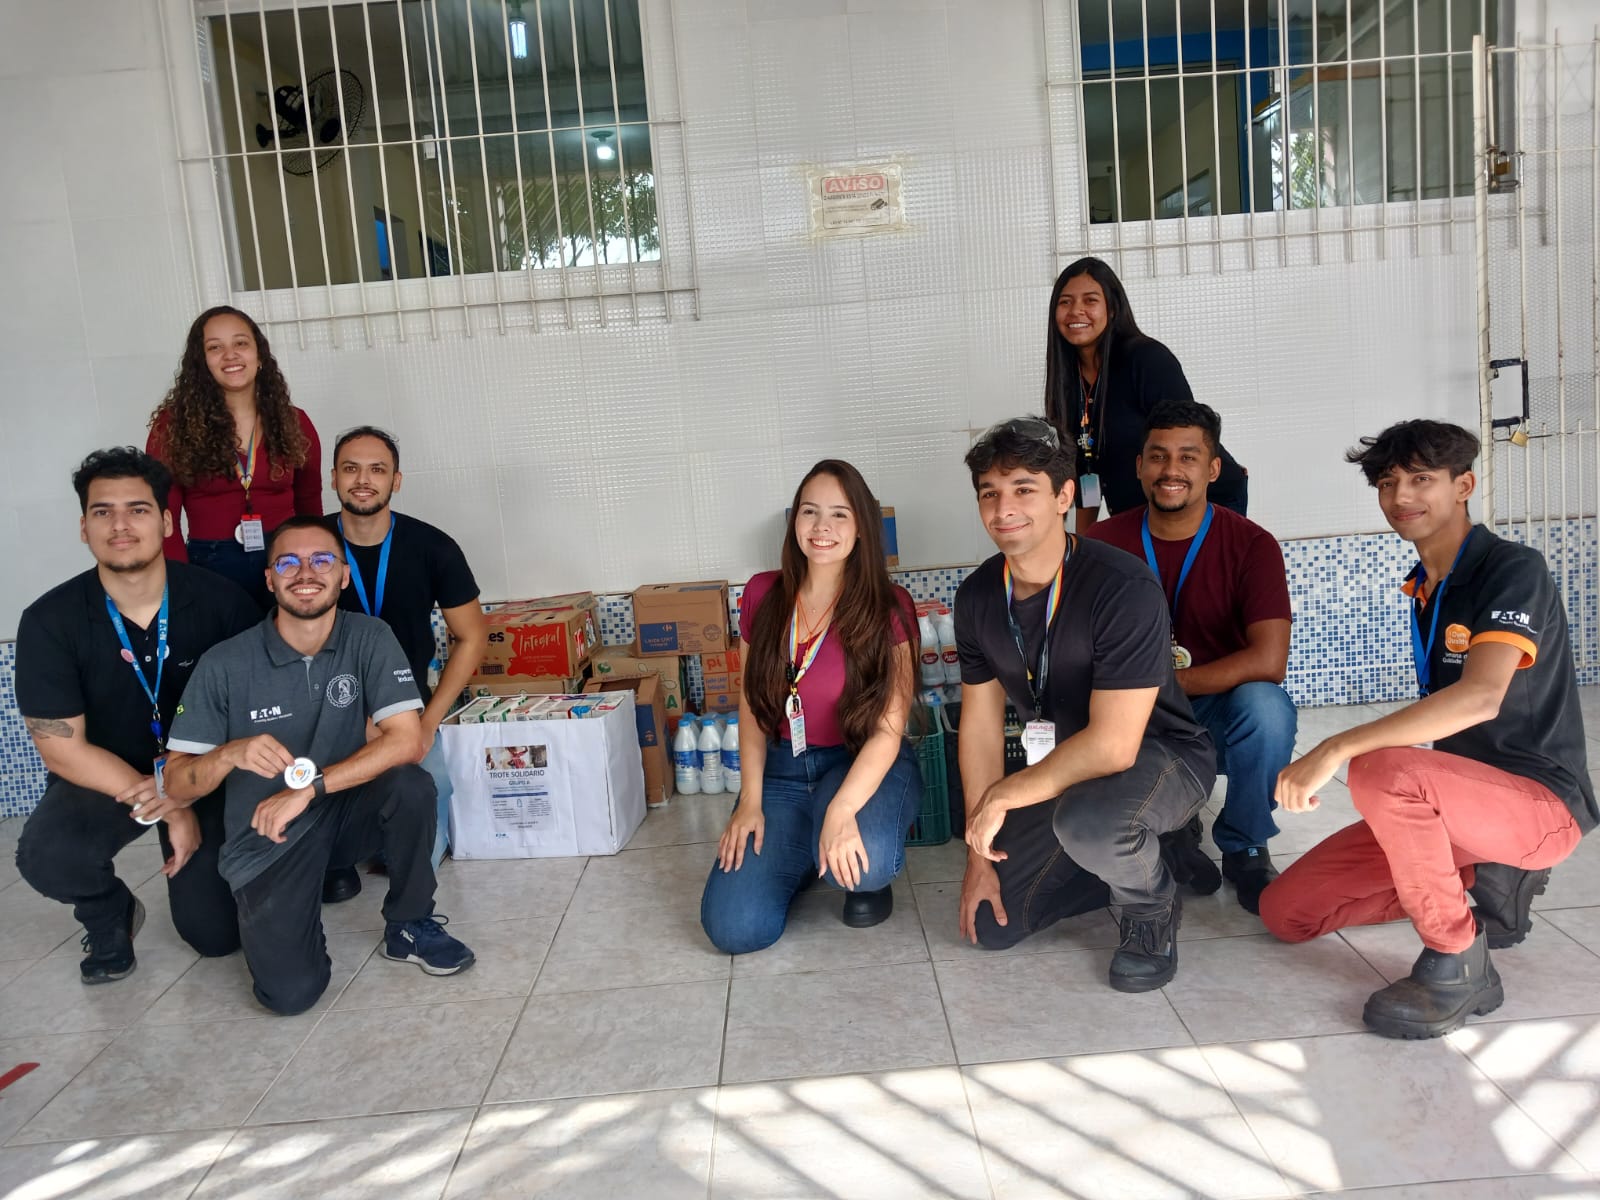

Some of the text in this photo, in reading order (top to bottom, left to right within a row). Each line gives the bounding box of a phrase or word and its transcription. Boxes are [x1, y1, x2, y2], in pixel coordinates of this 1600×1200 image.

[829, 177, 881, 191] AVISO
[1491, 611, 1530, 625] EATON
[488, 632, 504, 642] es
[520, 626, 561, 656] Integral
[250, 706, 281, 720] EATON
